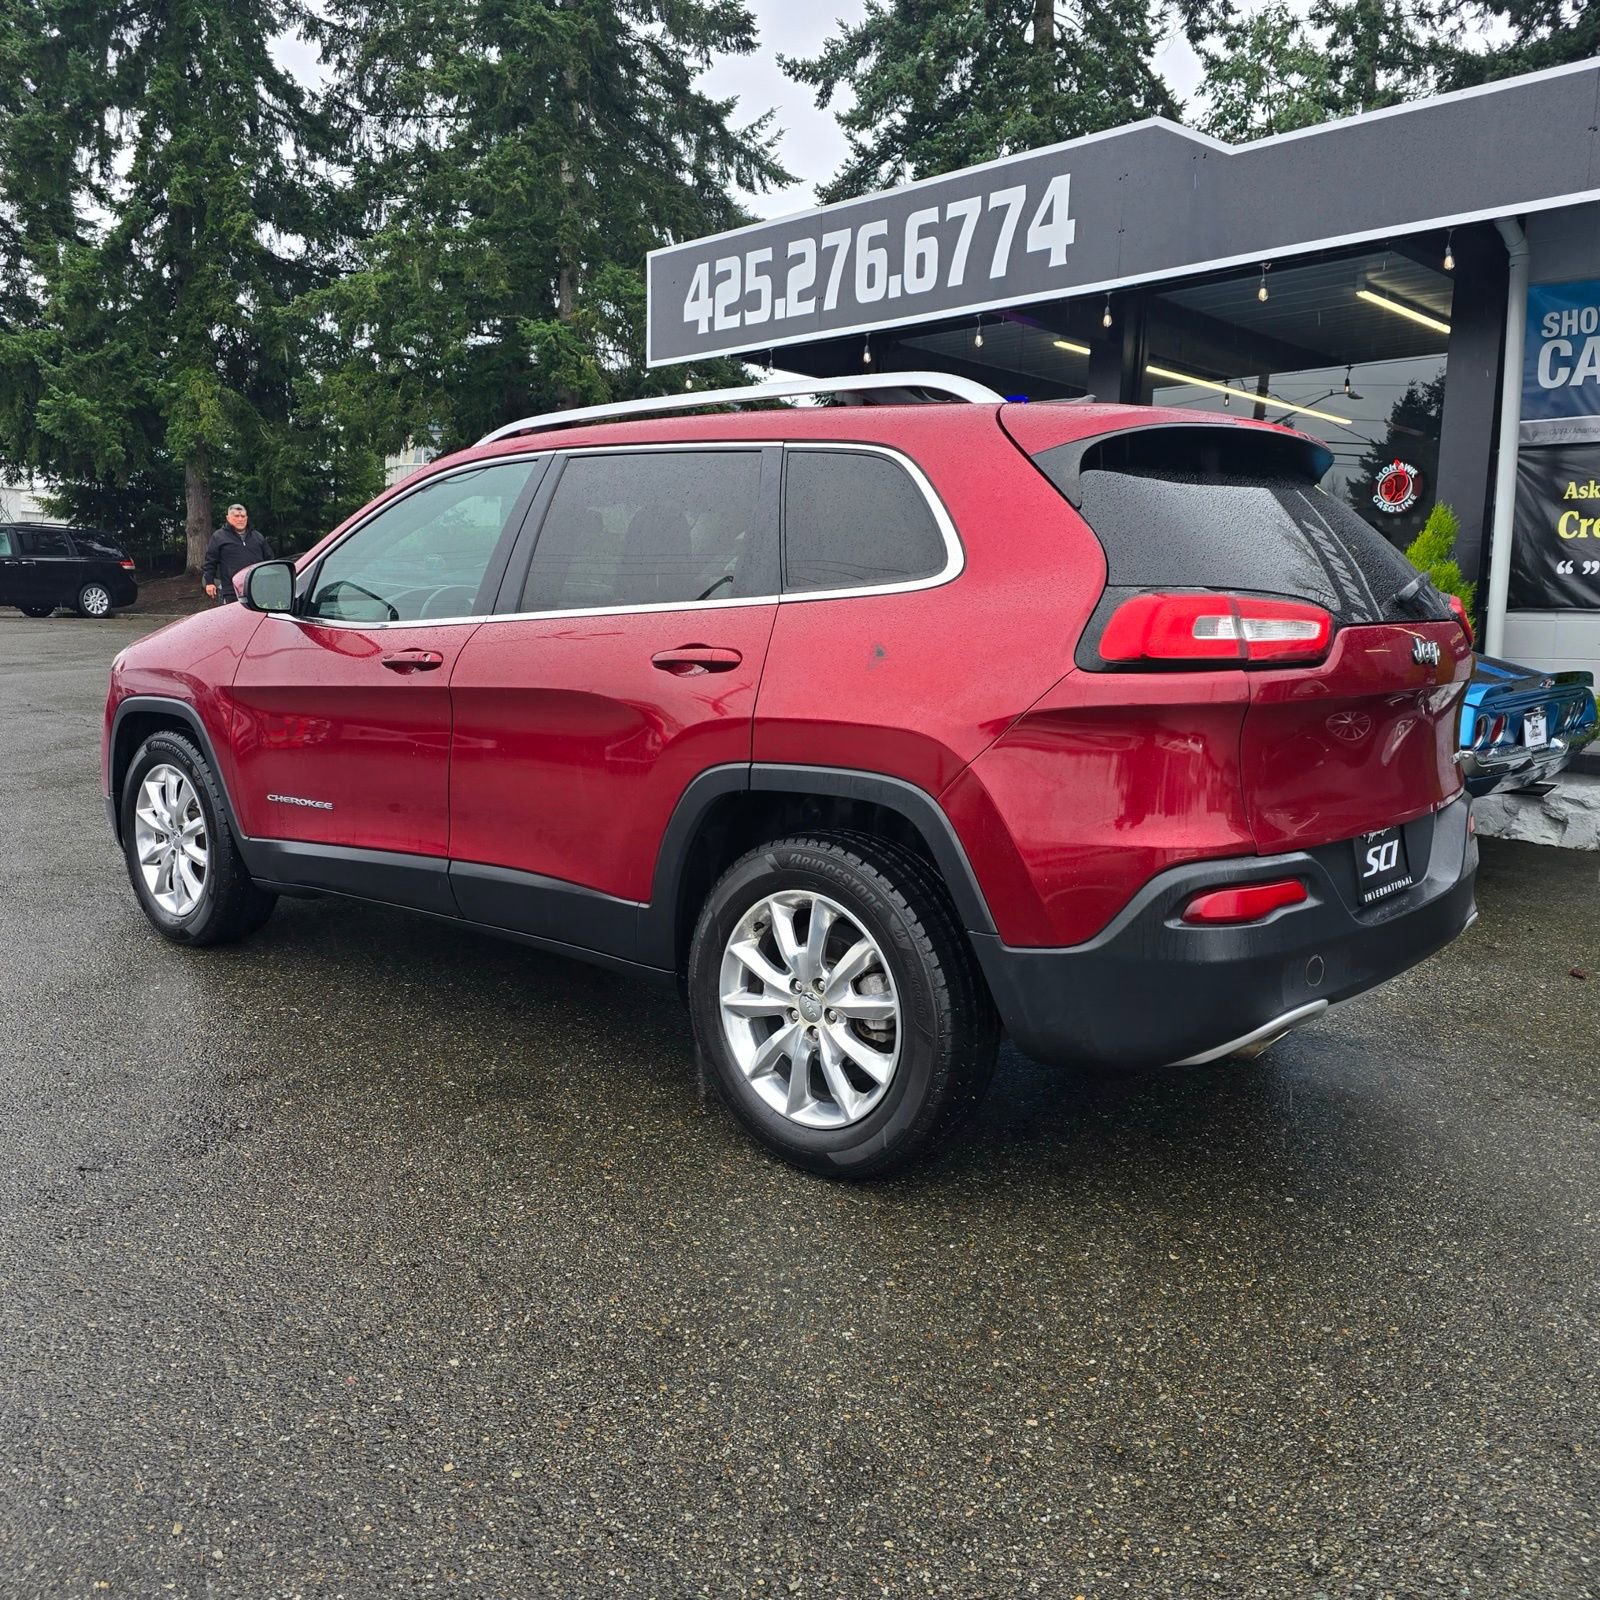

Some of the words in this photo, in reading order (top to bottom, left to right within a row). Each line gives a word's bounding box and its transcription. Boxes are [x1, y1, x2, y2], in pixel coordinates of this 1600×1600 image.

[683, 174, 1076, 335] 425.276.6774
[1541, 306, 1600, 338] SHO
[1375, 462, 1418, 481] MOHAWK
[1372, 493, 1417, 512] GASOLINE
[266, 794, 333, 810] CHEROKEE
[1364, 875, 1413, 903] INTERNATIONAL
